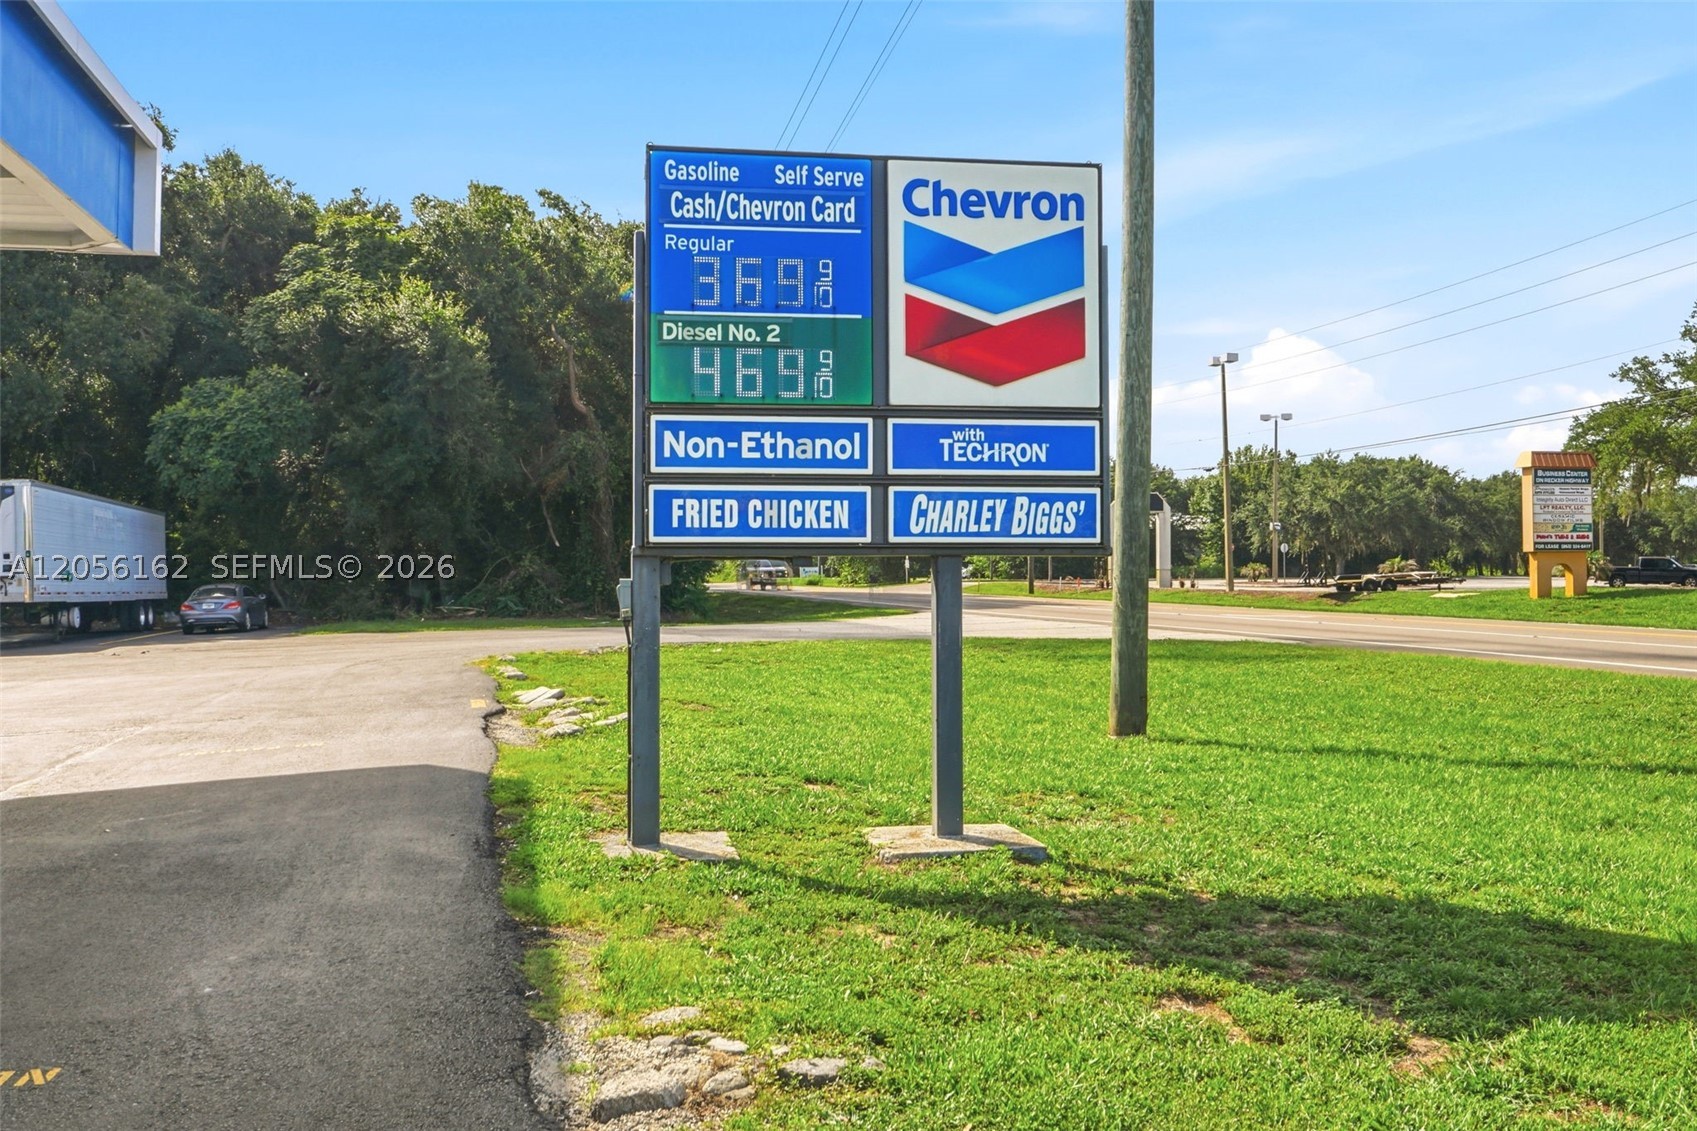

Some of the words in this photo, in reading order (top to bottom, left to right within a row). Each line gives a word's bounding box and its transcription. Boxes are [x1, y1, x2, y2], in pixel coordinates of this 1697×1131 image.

[664, 159, 740, 182] Gasoline
[774, 164, 808, 186] Self
[813, 166, 864, 187] Serve
[670, 190, 806, 221] Cash/Chevron
[811, 195, 856, 223] Card
[902, 178, 1085, 221] Chevron
[665, 234, 735, 254] Regular
[662, 322, 722, 341] Diesel
[728, 324, 761, 342] No.
[766, 324, 781, 342] 2
[663, 430, 861, 459] Non-Ethanol
[952, 428, 985, 441] with
[671, 498, 739, 528] FRIED
[747, 498, 849, 529] CHICKEN
[909, 493, 1007, 535] CHARLEY
[1010, 496, 1086, 536] BIGGS'
